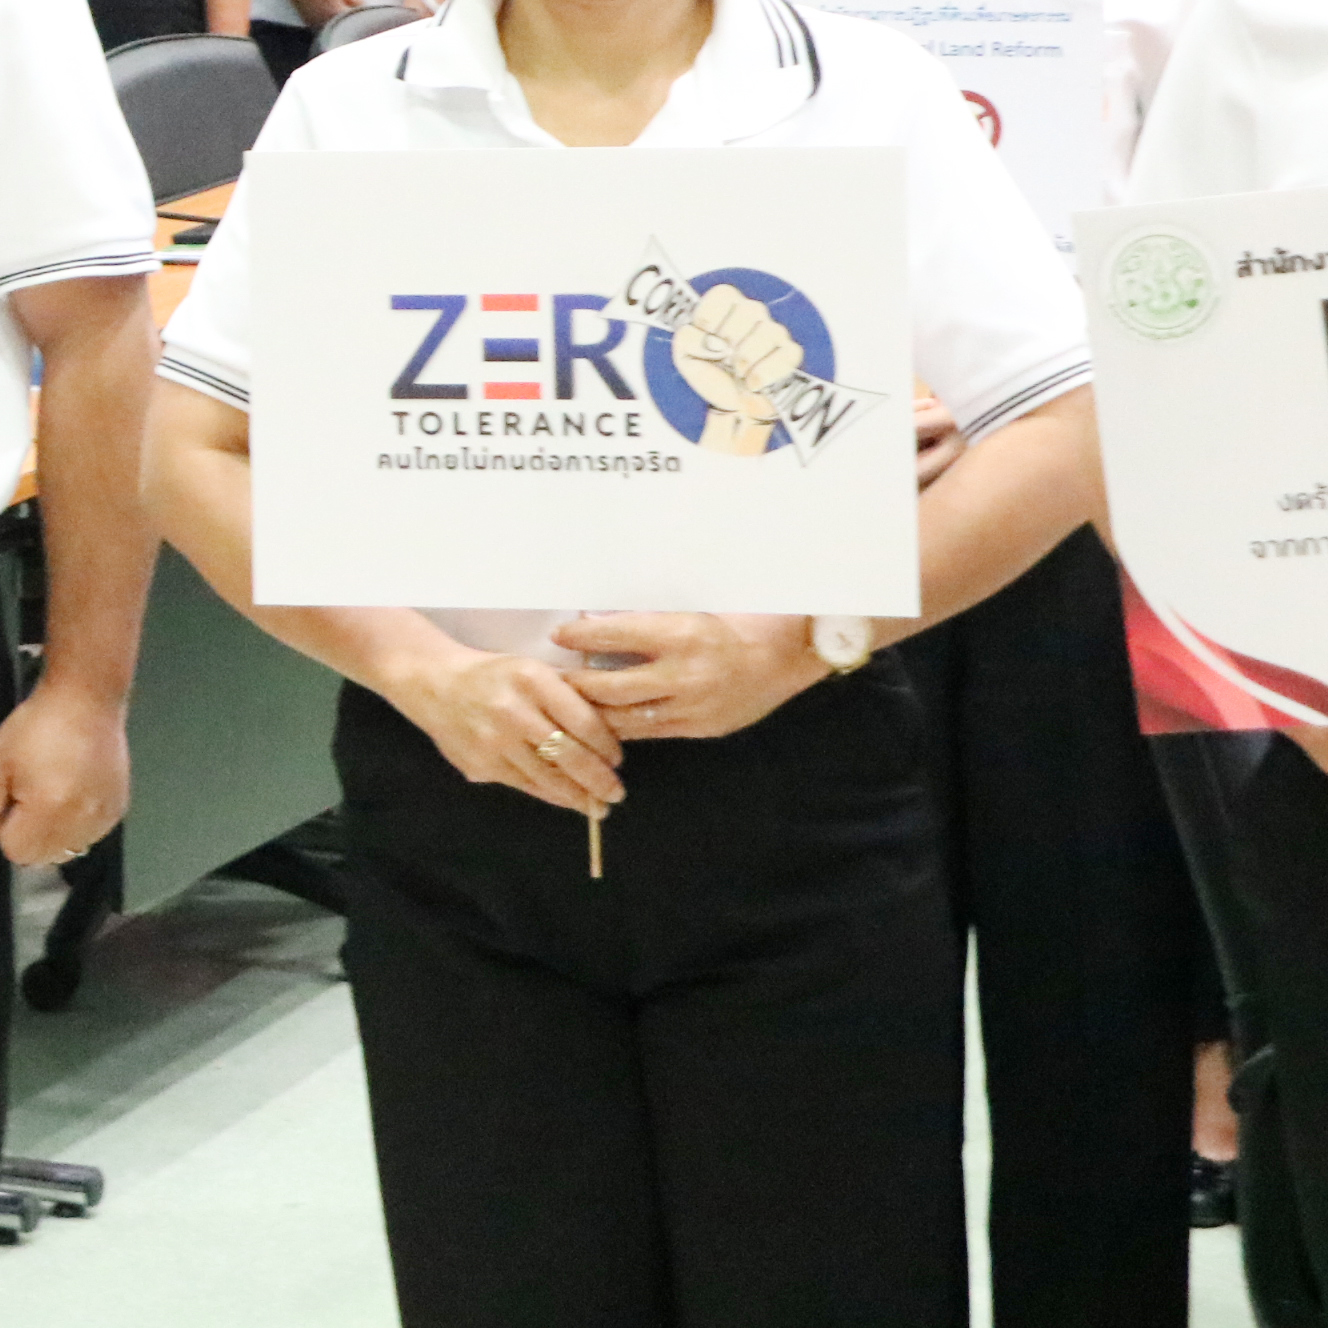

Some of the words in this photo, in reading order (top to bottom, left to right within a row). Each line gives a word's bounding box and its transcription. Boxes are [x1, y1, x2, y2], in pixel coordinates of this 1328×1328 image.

[940, 41, 985, 58] Land
[992, 41, 1062, 58] Reform
[391, 410, 642, 438] TOLERANCE
